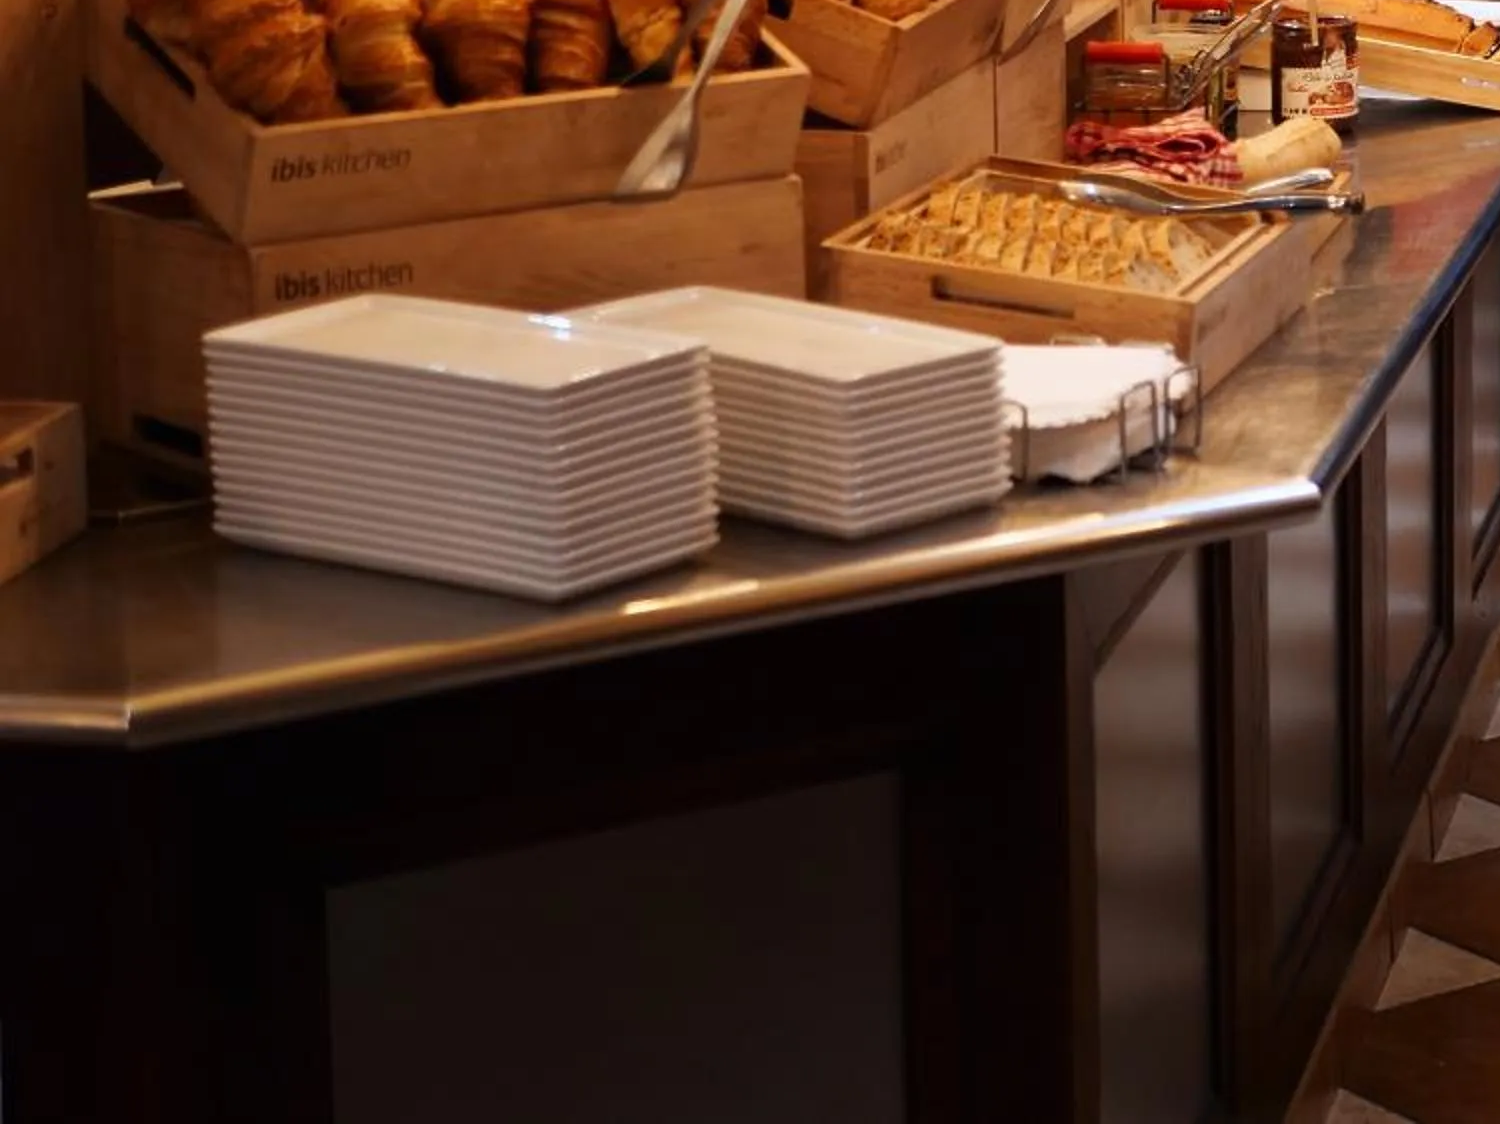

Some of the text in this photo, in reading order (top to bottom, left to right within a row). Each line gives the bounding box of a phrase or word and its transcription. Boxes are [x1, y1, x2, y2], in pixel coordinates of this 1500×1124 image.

[271, 146, 412, 183] ibis kitchen
[275, 261, 414, 302] ibis kitchen
